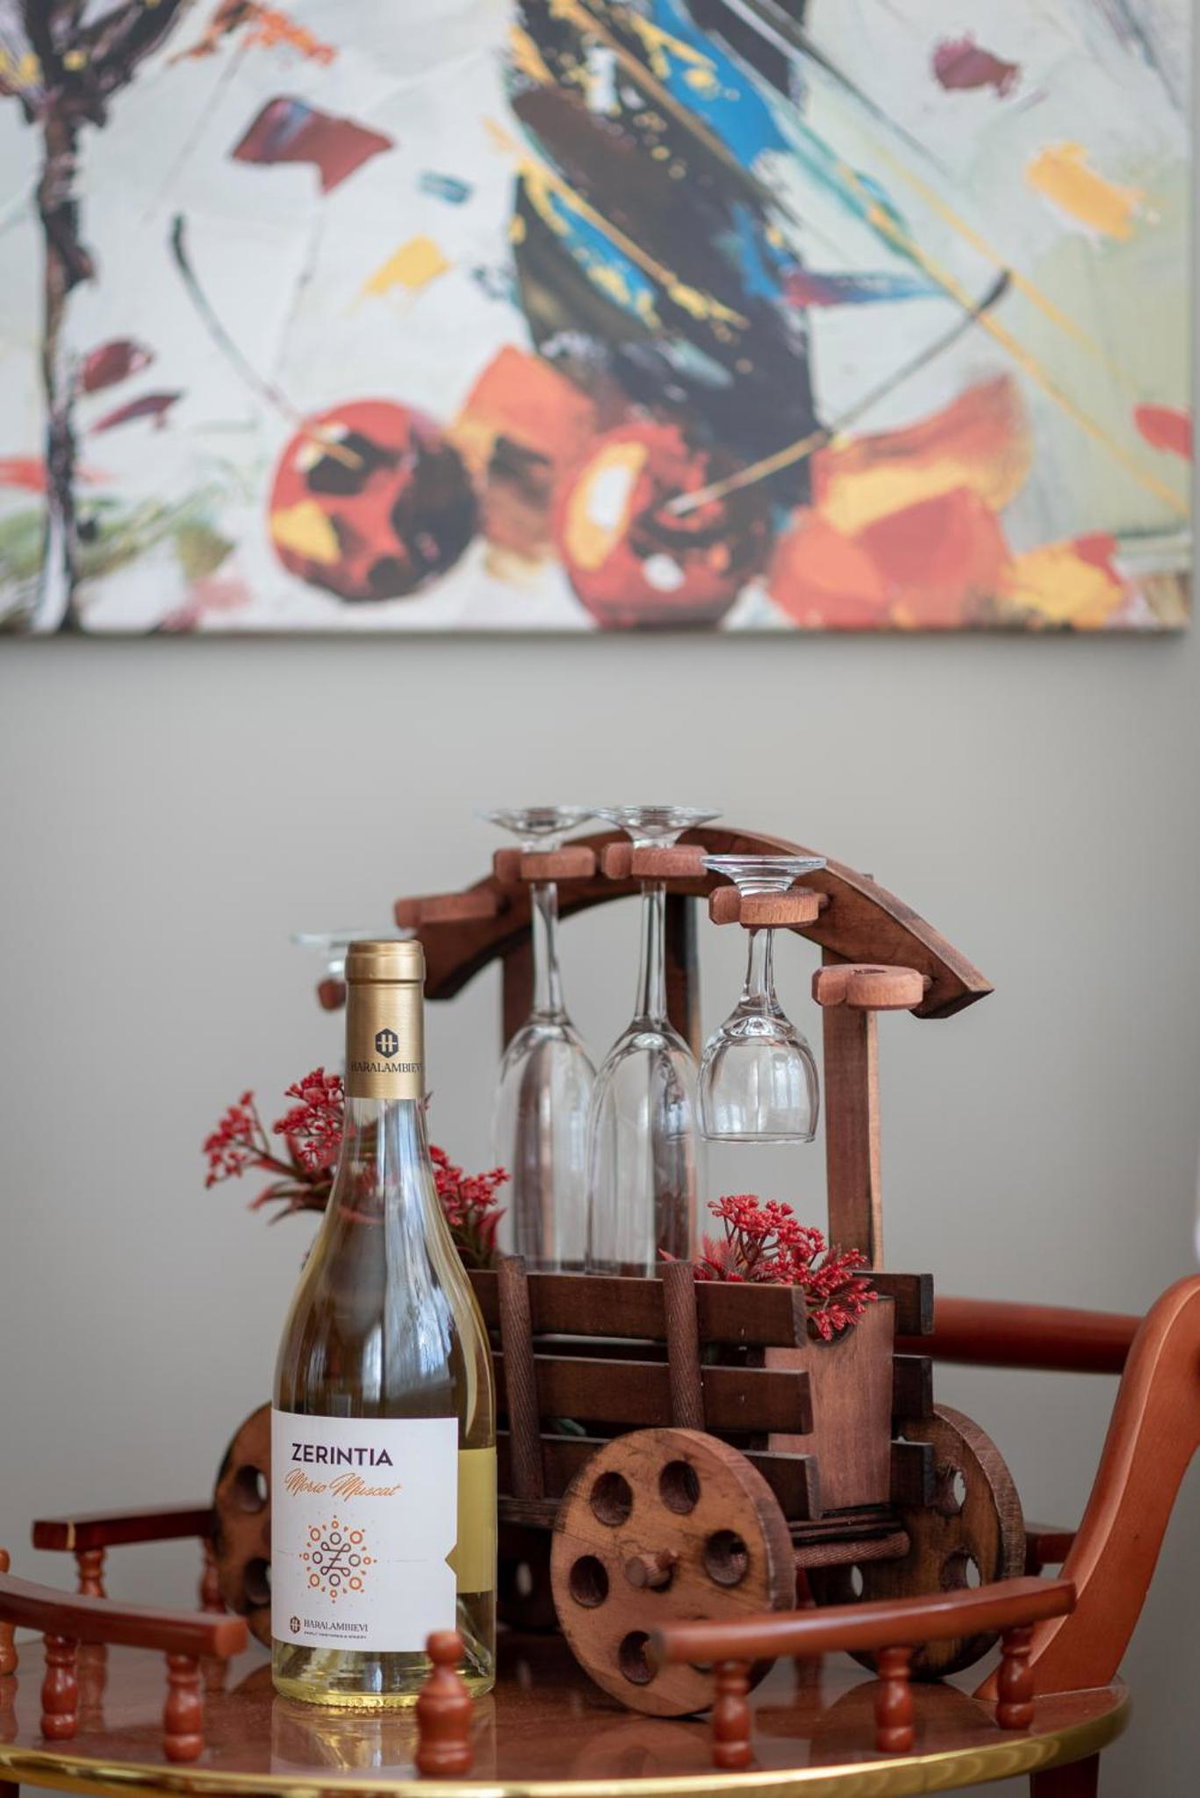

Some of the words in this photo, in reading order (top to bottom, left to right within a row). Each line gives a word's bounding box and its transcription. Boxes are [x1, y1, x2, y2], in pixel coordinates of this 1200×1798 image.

[291, 1443, 394, 1467] ZERINTIA
[329, 1473, 402, 1502] Muscat
[303, 1619, 369, 1632] HARALAMBIEVI
